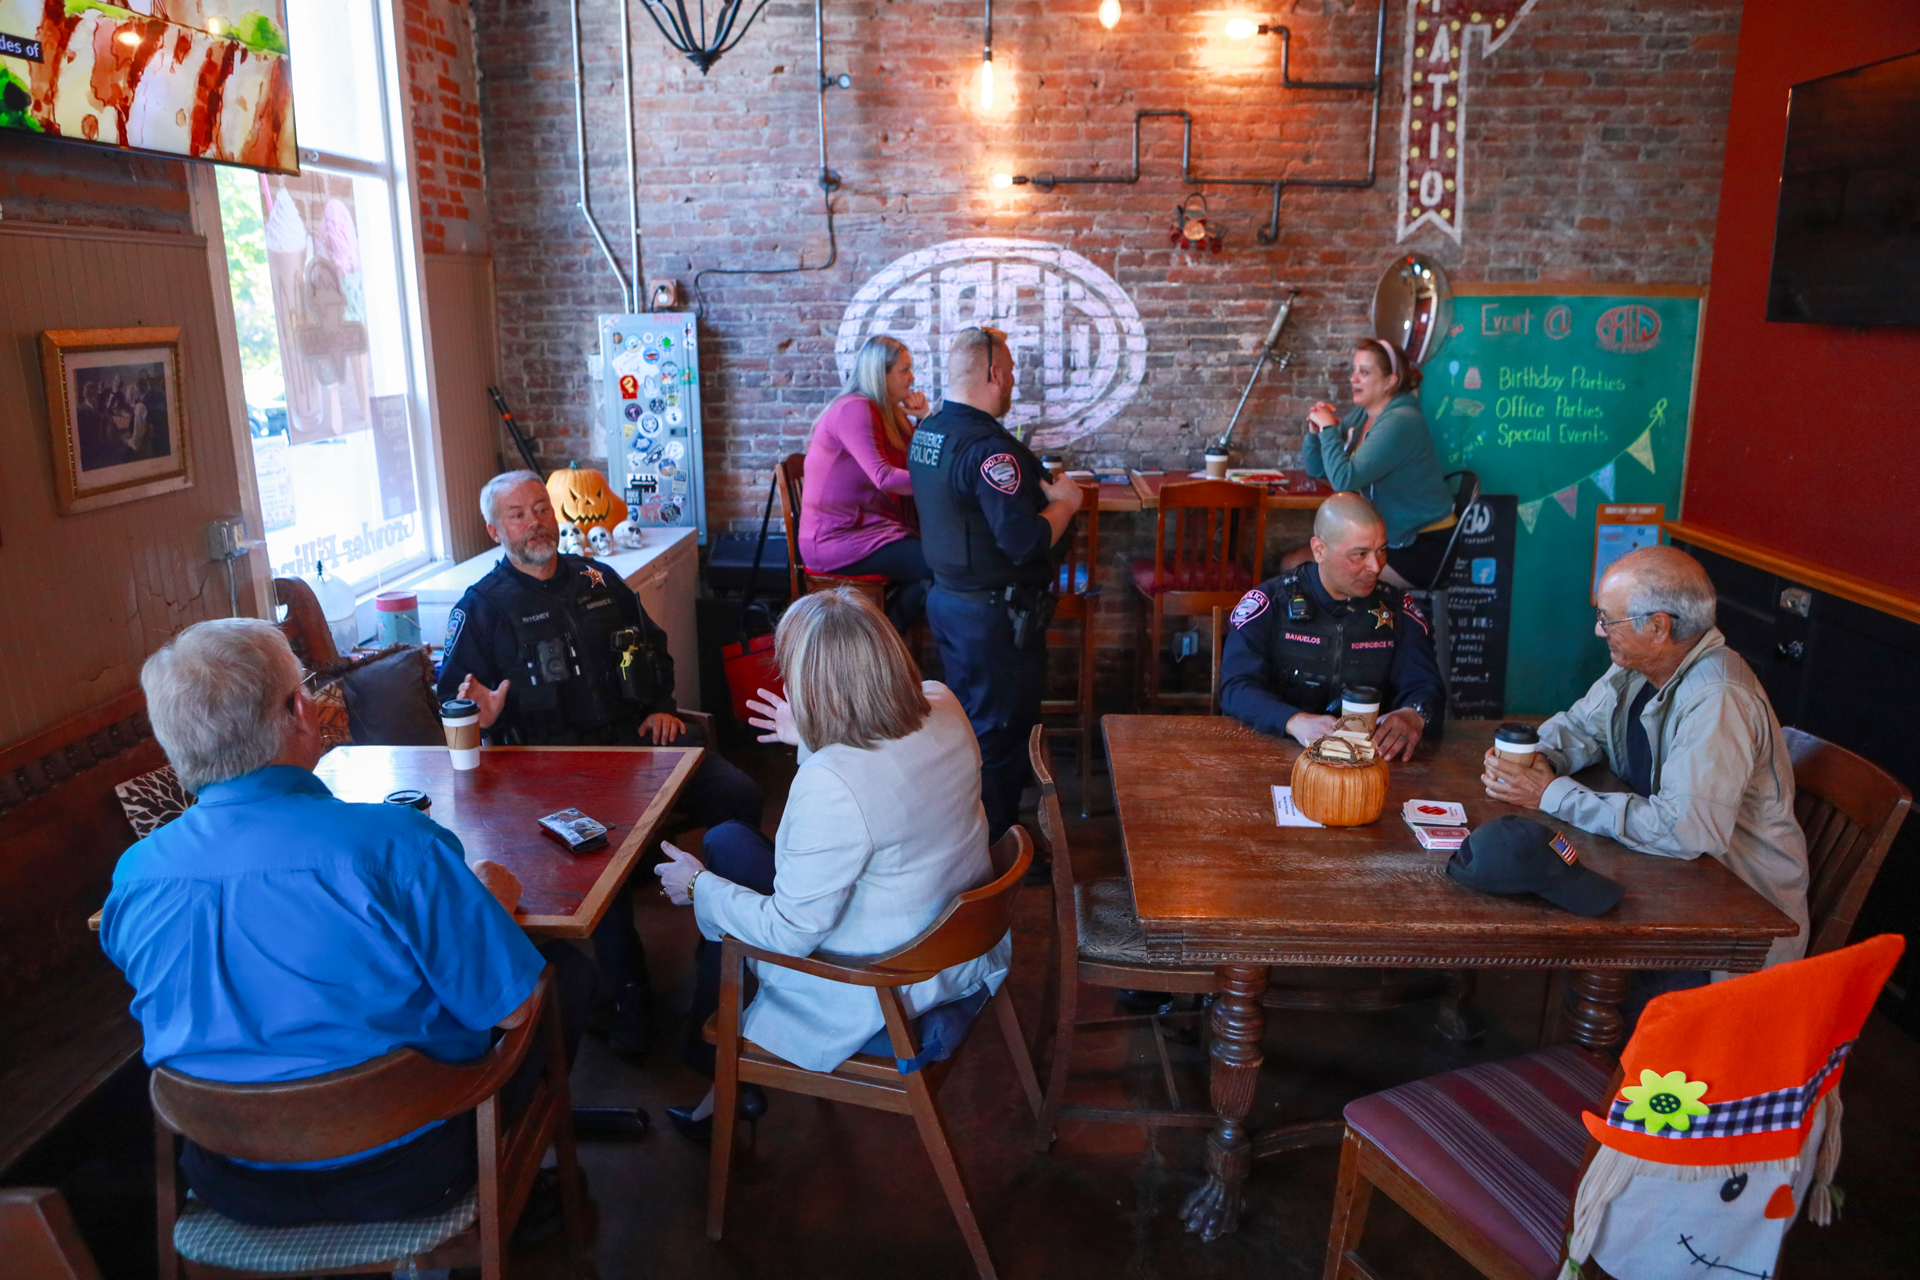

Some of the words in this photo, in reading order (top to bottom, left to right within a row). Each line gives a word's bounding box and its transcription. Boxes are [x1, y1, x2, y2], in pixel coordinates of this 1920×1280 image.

[25, 43, 40, 58] of
[1419, 0, 1451, 207] ATIO
[1481, 303, 1535, 336] Event
[1499, 364, 1565, 392] Birthday
[1571, 364, 1626, 391] Parties
[1495, 394, 1545, 419] Office
[1556, 395, 1604, 419] Parties
[1497, 423, 1551, 449] Special
[1560, 423, 1609, 444] Events
[909, 444, 940, 467] POLICE
[983, 455, 1014, 473] POLICE
[1285, 632, 1321, 645] BANUELOS
